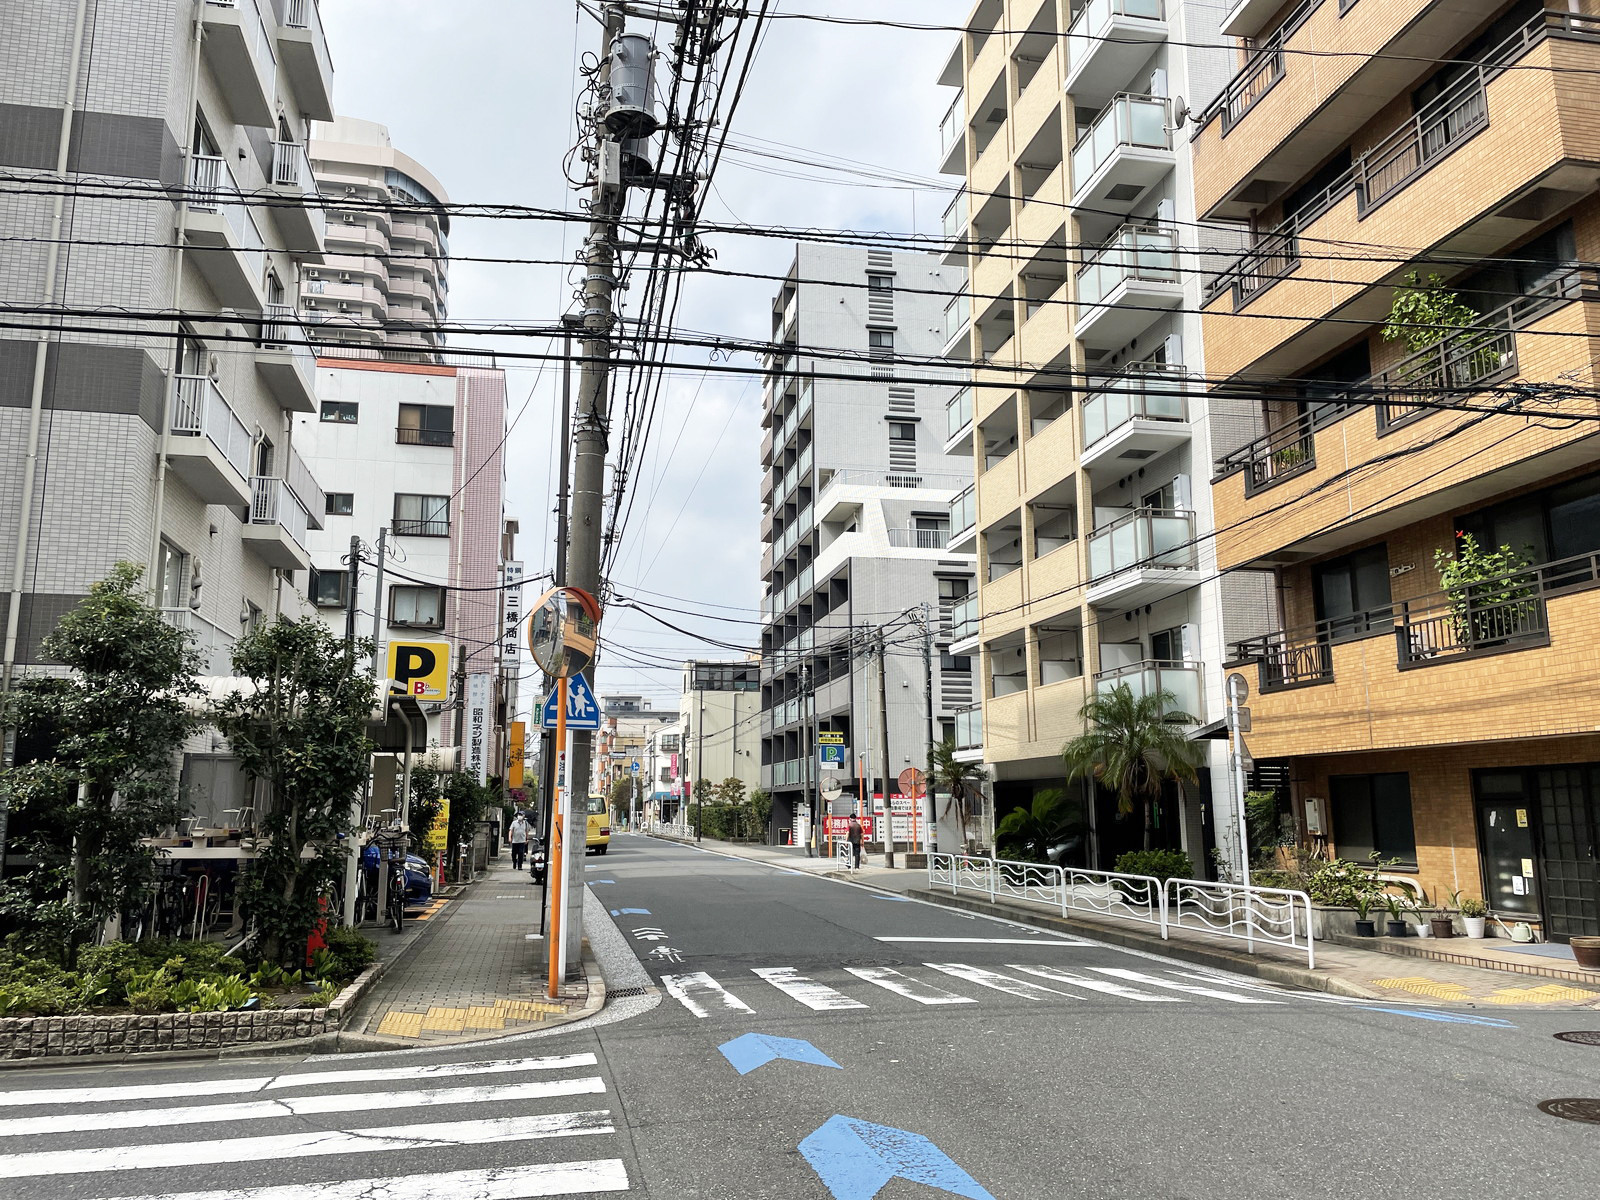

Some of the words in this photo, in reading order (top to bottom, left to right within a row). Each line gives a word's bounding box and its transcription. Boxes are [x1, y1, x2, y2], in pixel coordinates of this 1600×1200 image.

[504, 596, 519, 655] 三橋商店
[394, 645, 436, 694] P
[825, 746, 838, 762] P
